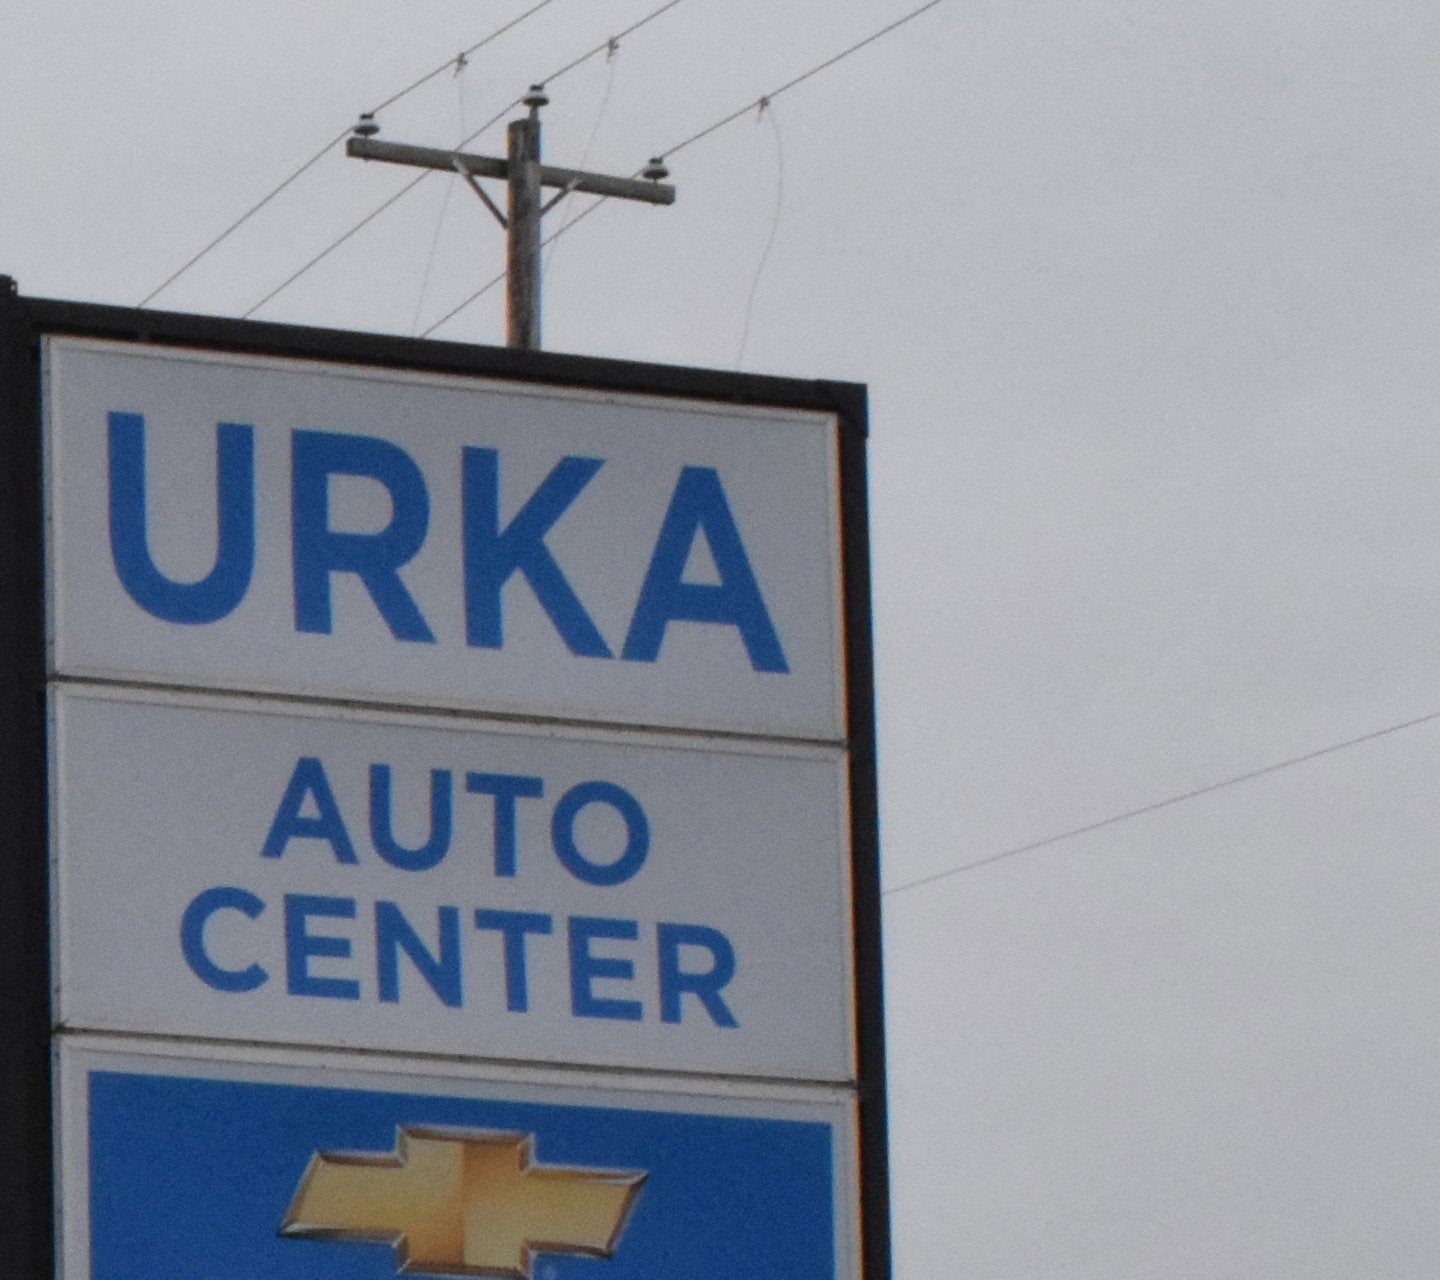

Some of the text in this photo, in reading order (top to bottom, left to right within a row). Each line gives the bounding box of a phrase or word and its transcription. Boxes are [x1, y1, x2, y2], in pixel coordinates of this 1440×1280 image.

[107, 411, 789, 674] URKA
[261, 757, 651, 886] AUTO
[179, 886, 739, 1028] CENTER
